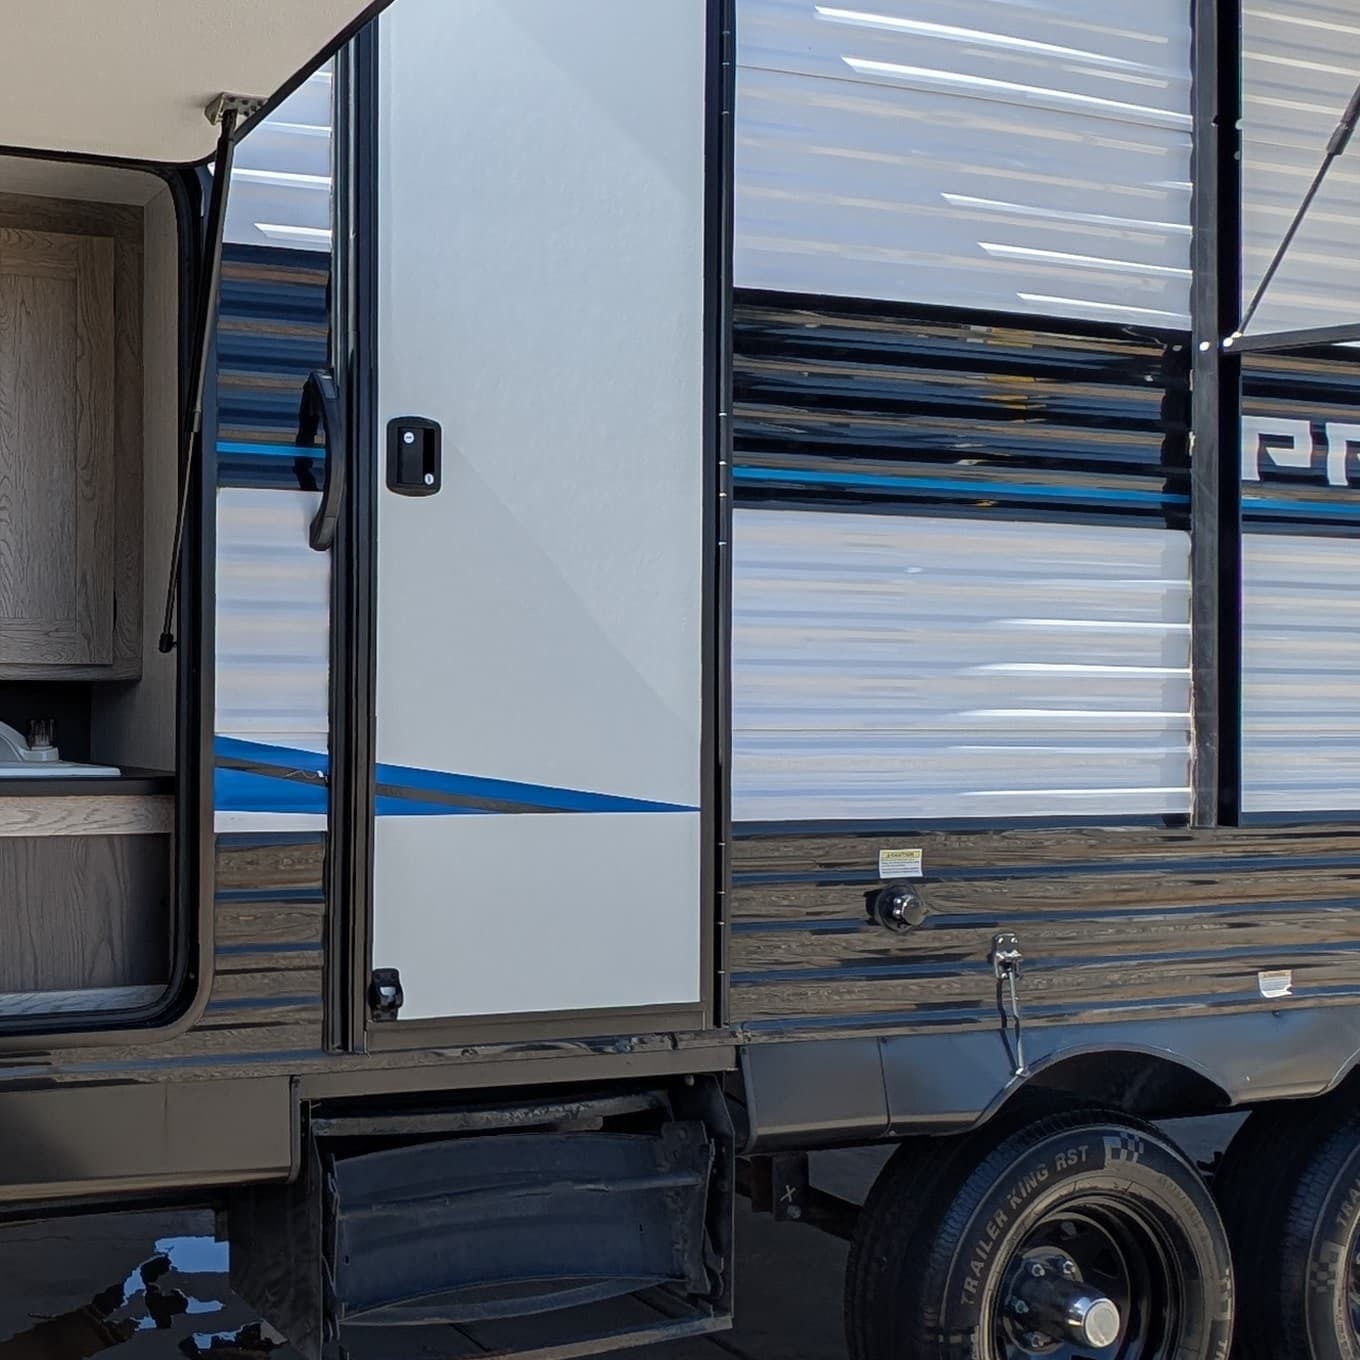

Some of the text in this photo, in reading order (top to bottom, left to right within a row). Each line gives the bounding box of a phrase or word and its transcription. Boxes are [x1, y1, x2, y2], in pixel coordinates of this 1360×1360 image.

[961, 1145, 1089, 1305] TRAILER KING RST
